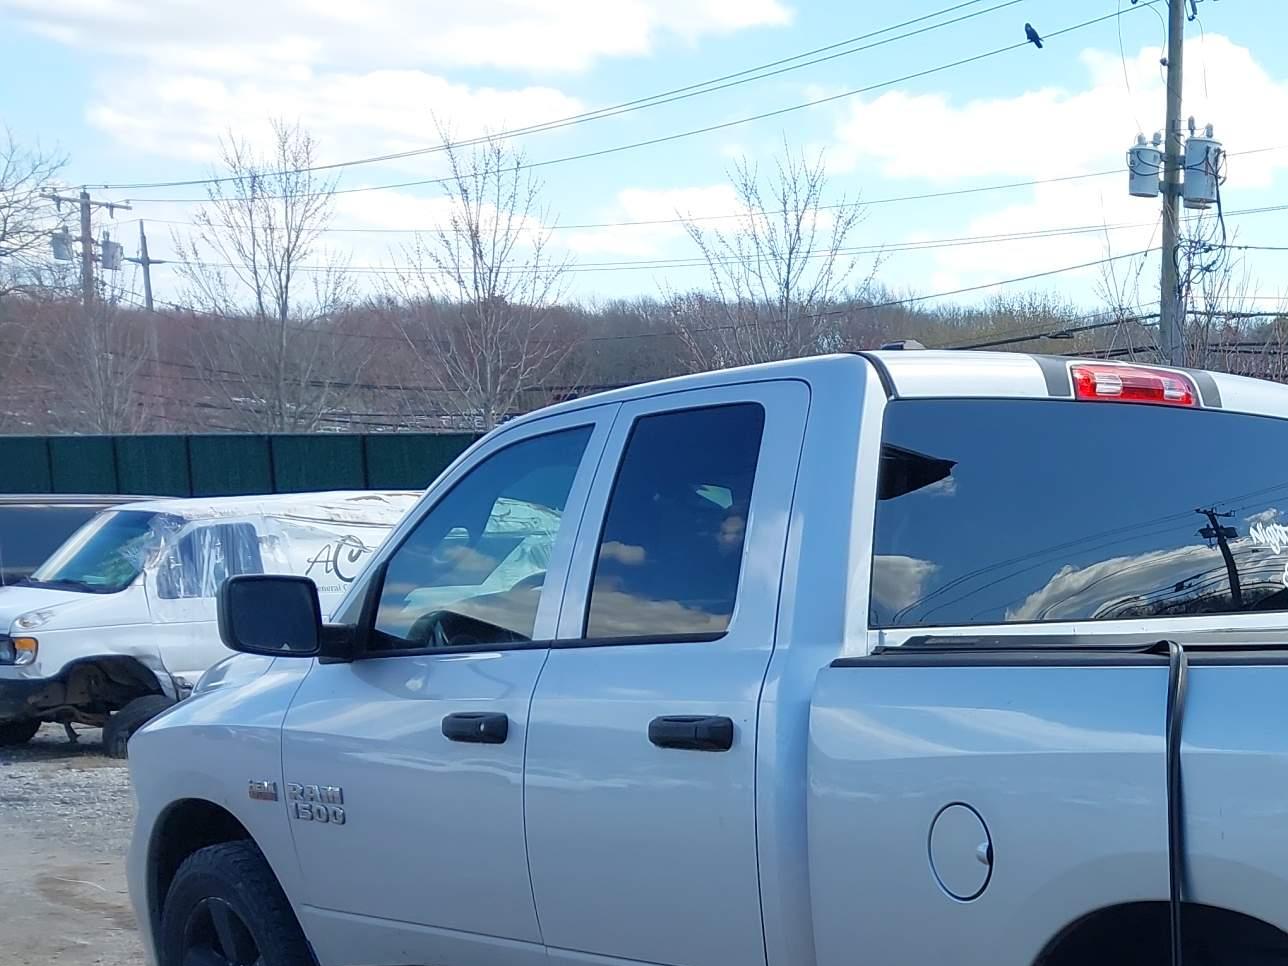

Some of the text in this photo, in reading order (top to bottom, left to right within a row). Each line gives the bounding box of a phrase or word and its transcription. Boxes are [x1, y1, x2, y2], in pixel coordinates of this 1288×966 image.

[317, 583, 341, 592] eneral
[287, 782, 344, 805] RAM
[289, 802, 346, 826] 1500
